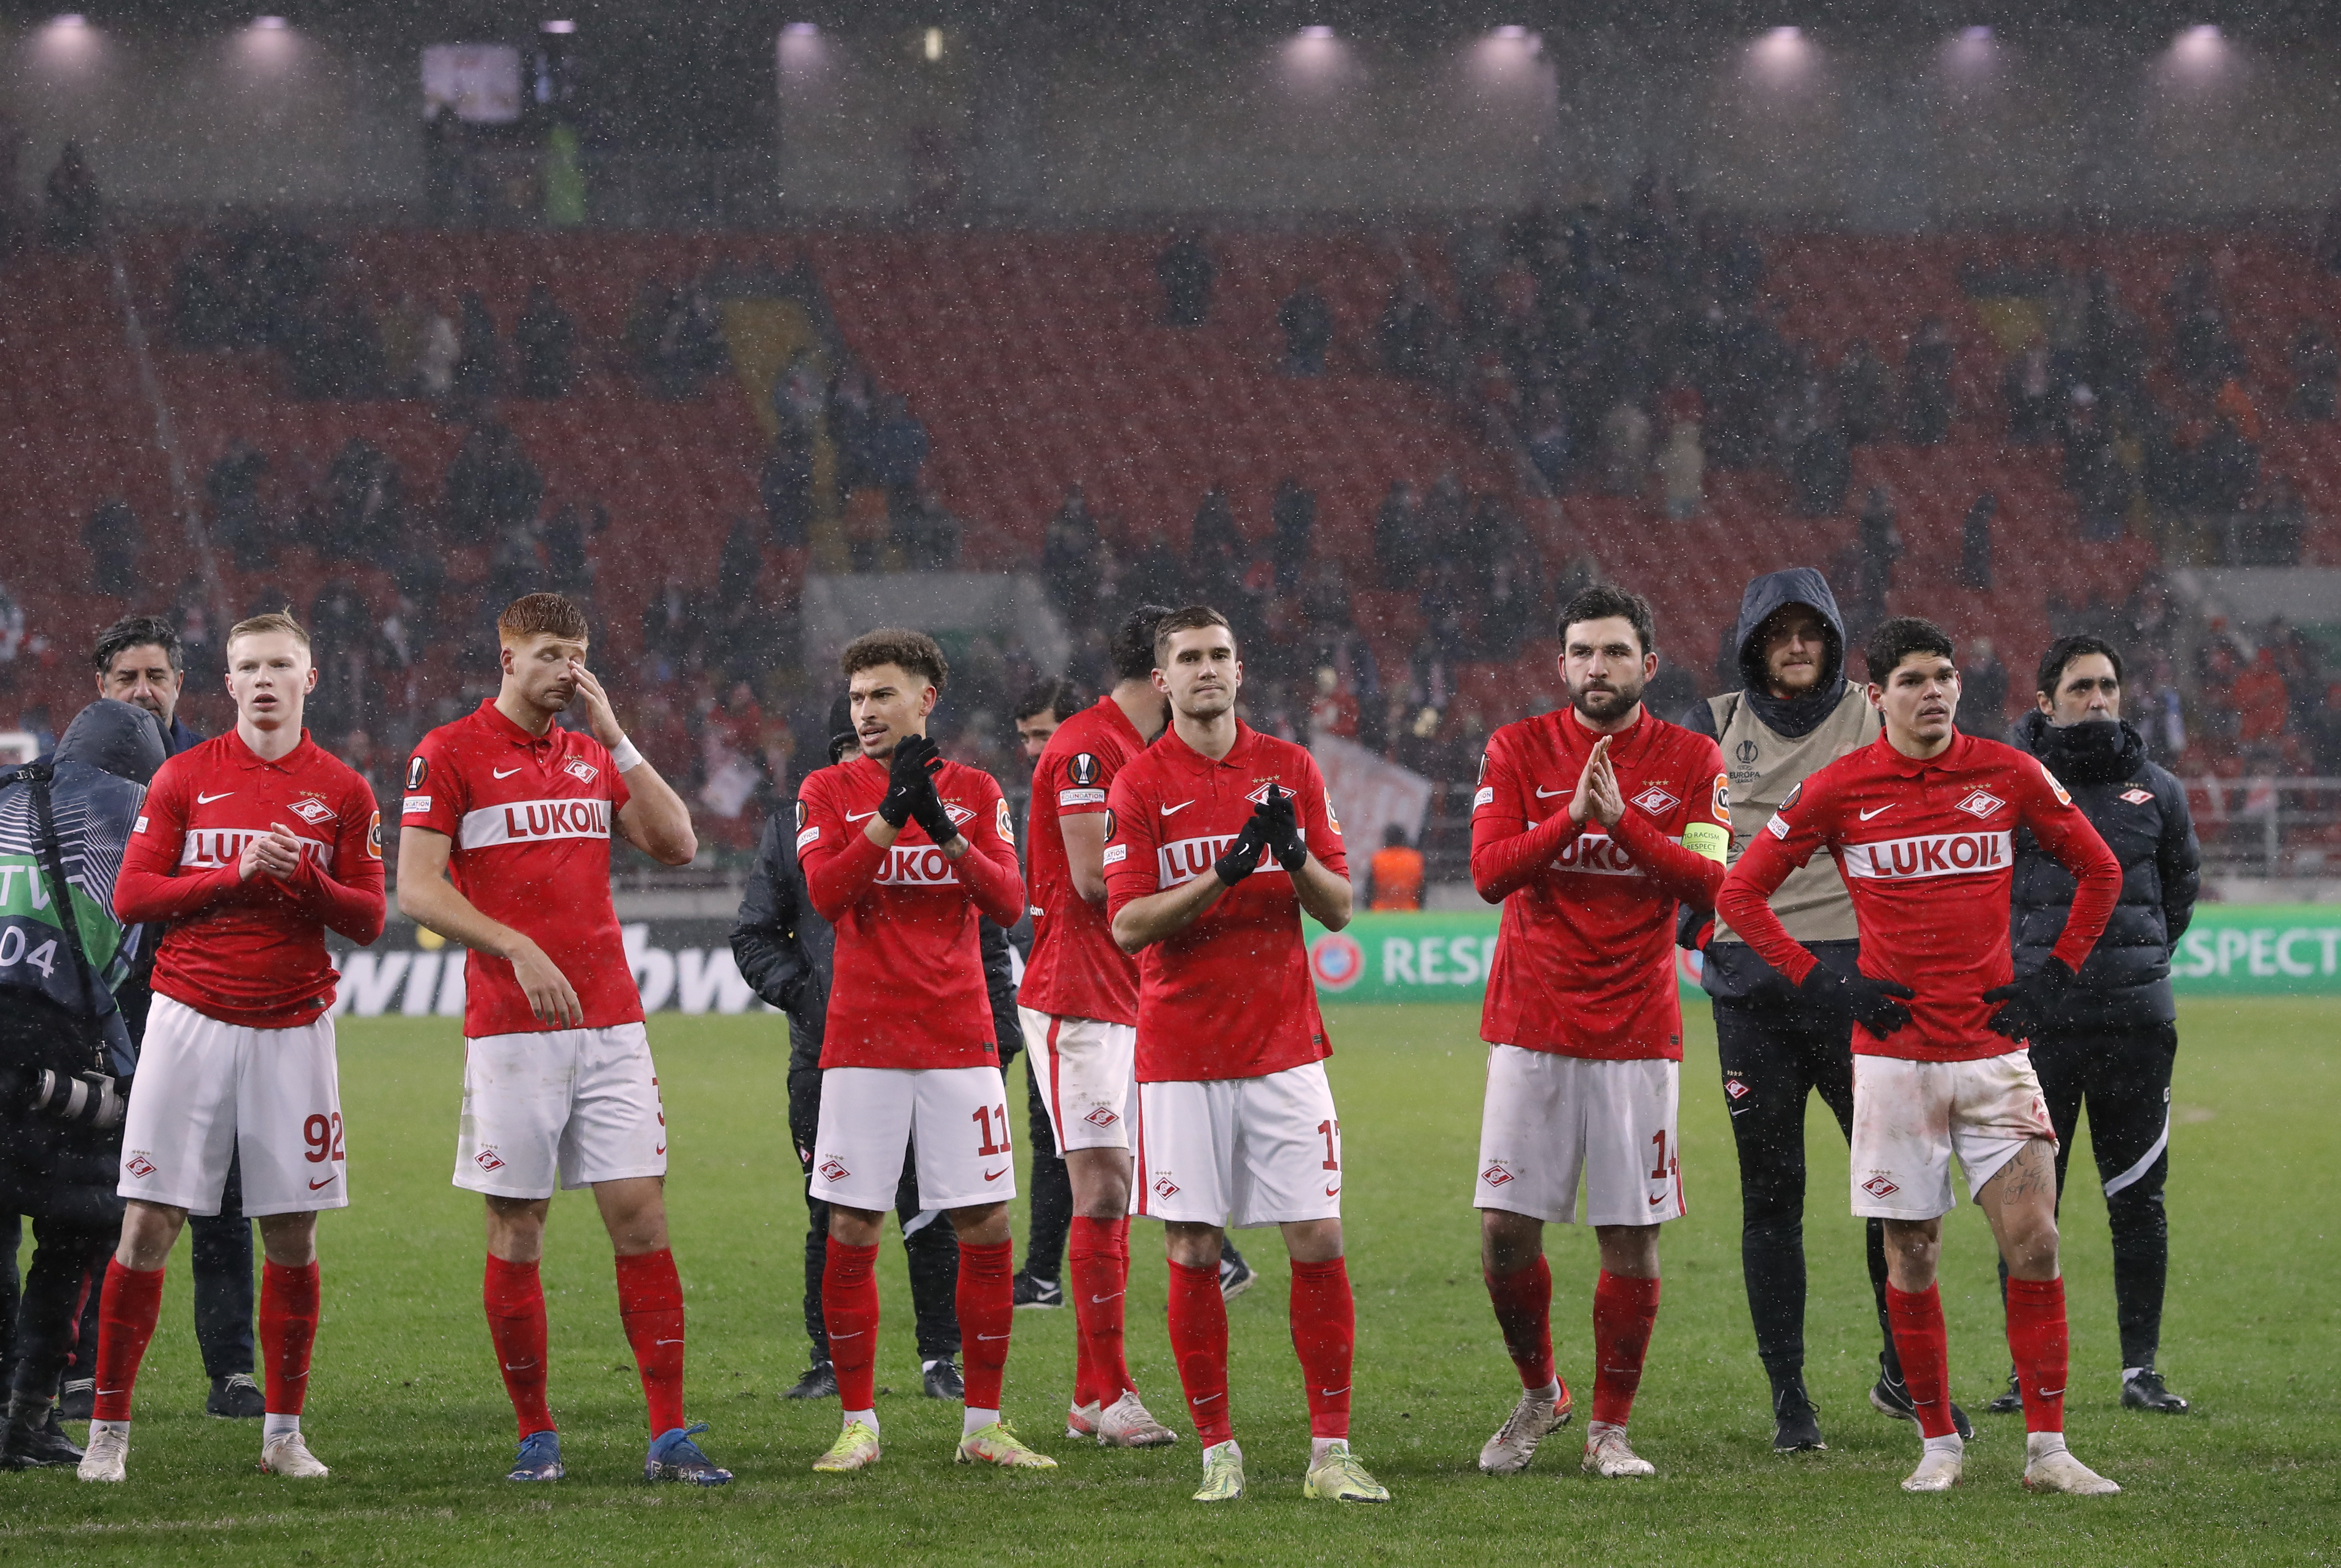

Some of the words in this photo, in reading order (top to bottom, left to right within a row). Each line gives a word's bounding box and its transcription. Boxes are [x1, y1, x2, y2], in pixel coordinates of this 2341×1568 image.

[505, 802, 607, 838] LUKOIL
[1694, 832, 1720, 840] RACISM
[1868, 835, 2001, 876] LUKOIL
[0, 925, 58, 979] 04
[304, 1111, 344, 1163] 92
[972, 1103, 1011, 1156] 11
